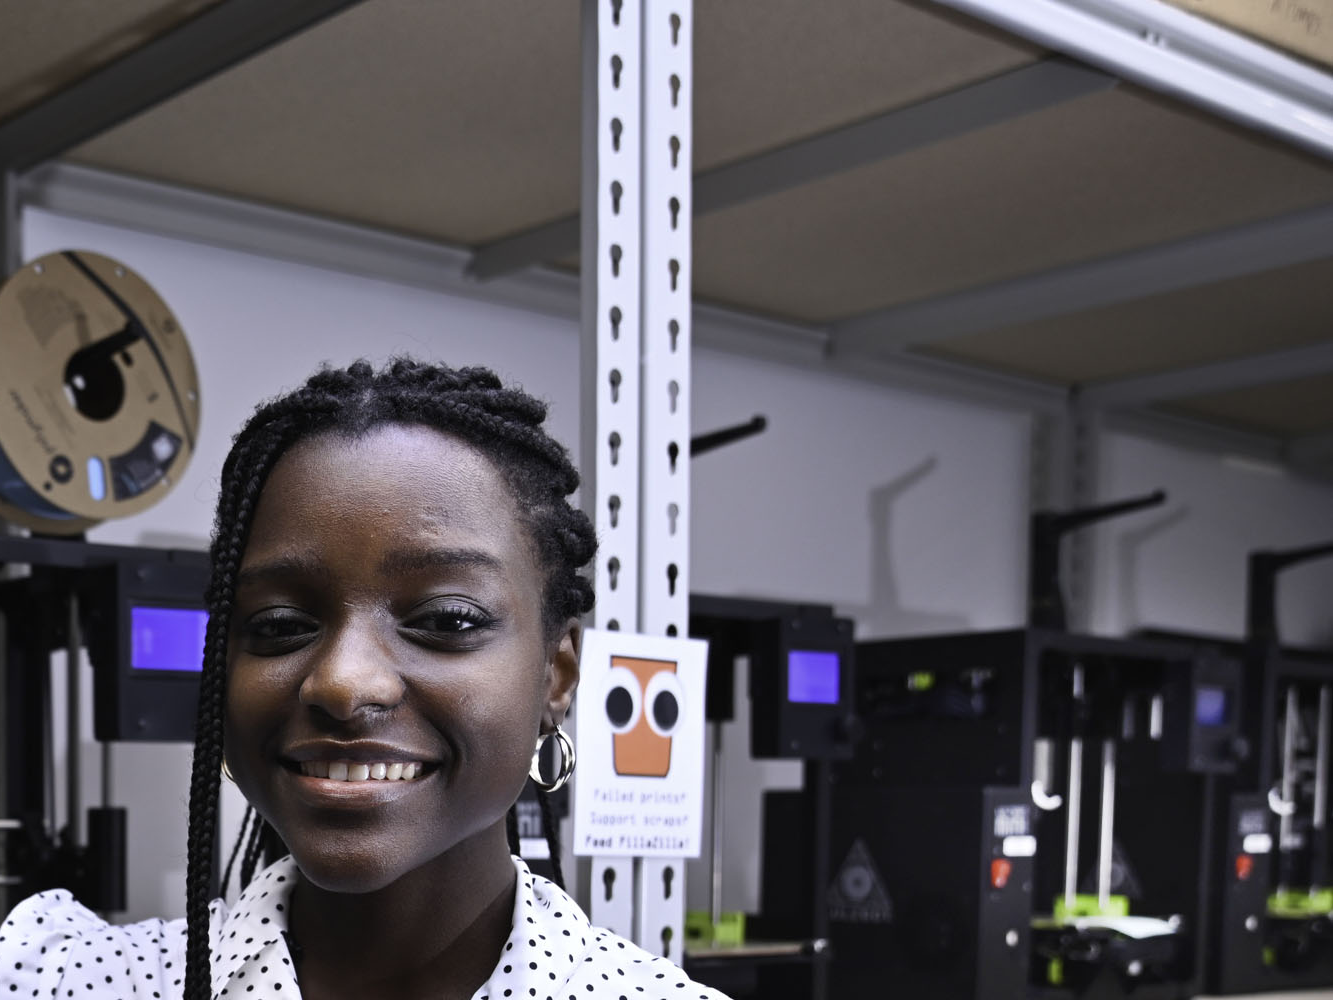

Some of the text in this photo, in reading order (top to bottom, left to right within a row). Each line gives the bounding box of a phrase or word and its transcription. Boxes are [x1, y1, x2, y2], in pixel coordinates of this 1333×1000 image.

[593, 788, 635, 803] Failed
[590, 811, 636, 826] Support
[585, 834, 613, 849] Feed
